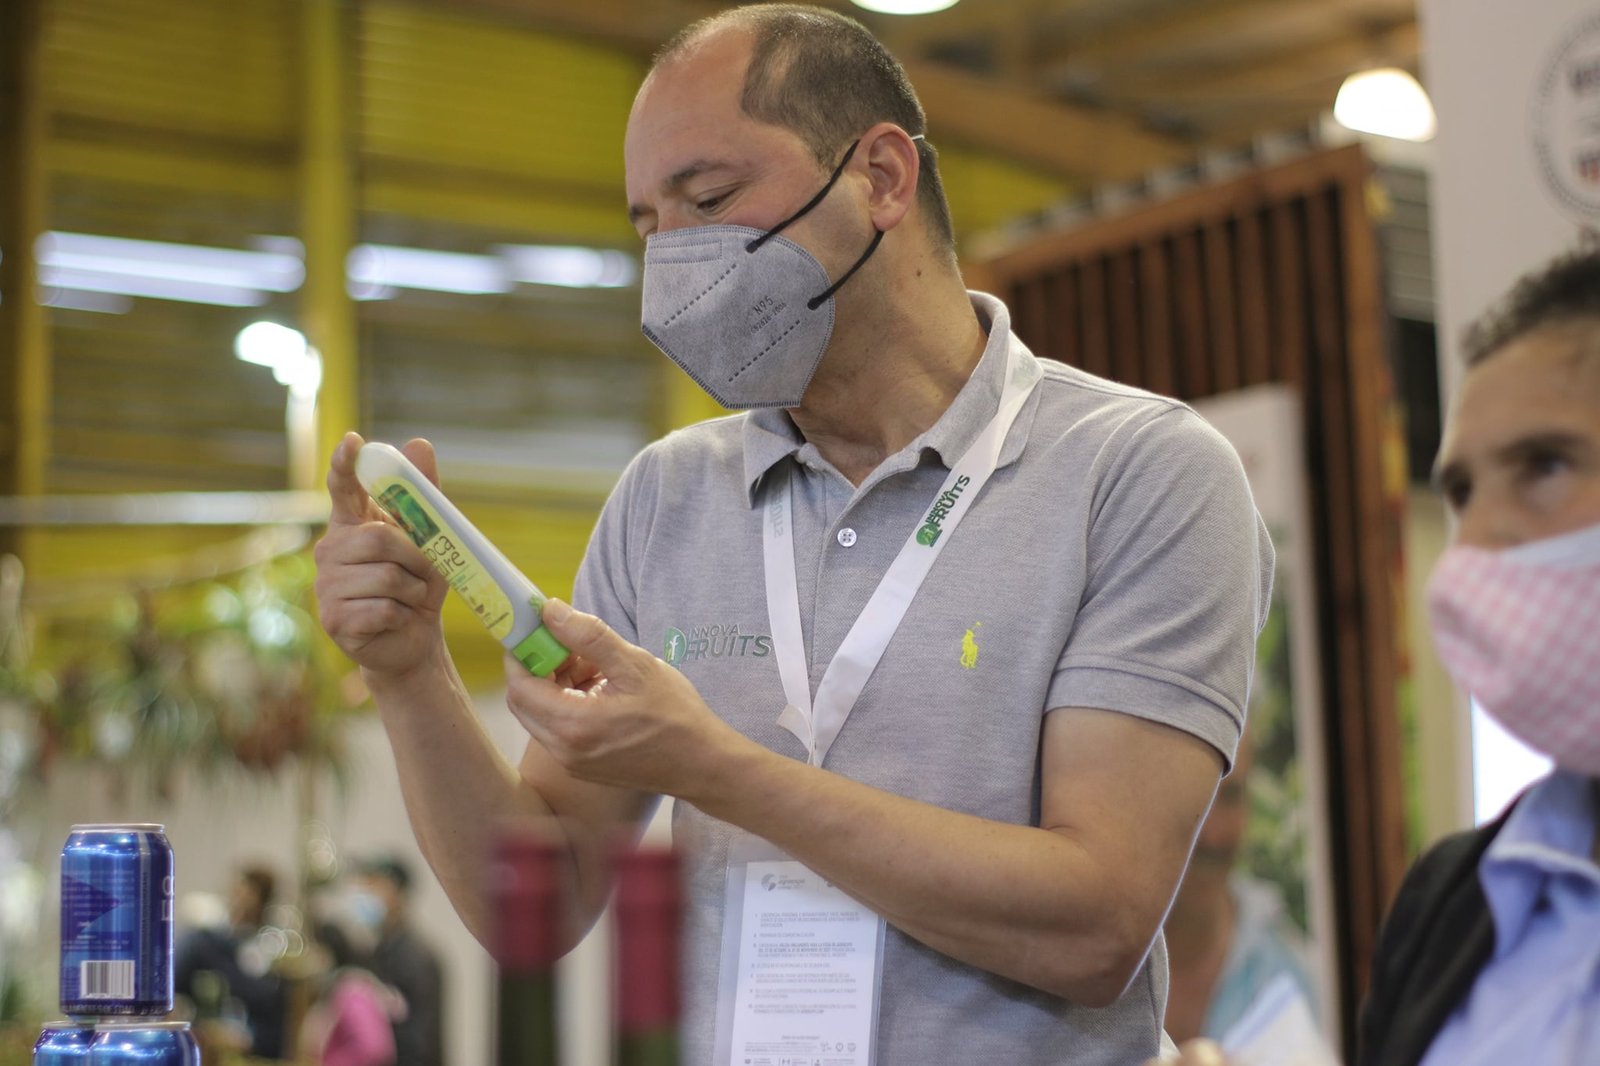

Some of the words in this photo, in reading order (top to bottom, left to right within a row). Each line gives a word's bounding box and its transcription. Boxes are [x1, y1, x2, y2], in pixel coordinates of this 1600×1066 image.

[752, 295, 773, 315] N95
[925, 490, 951, 523] INNOVA
[931, 474, 971, 528] FRUITS
[423, 535, 456, 563] oca
[689, 623, 741, 641] INNOVA
[685, 634, 772, 661] FRUITS
